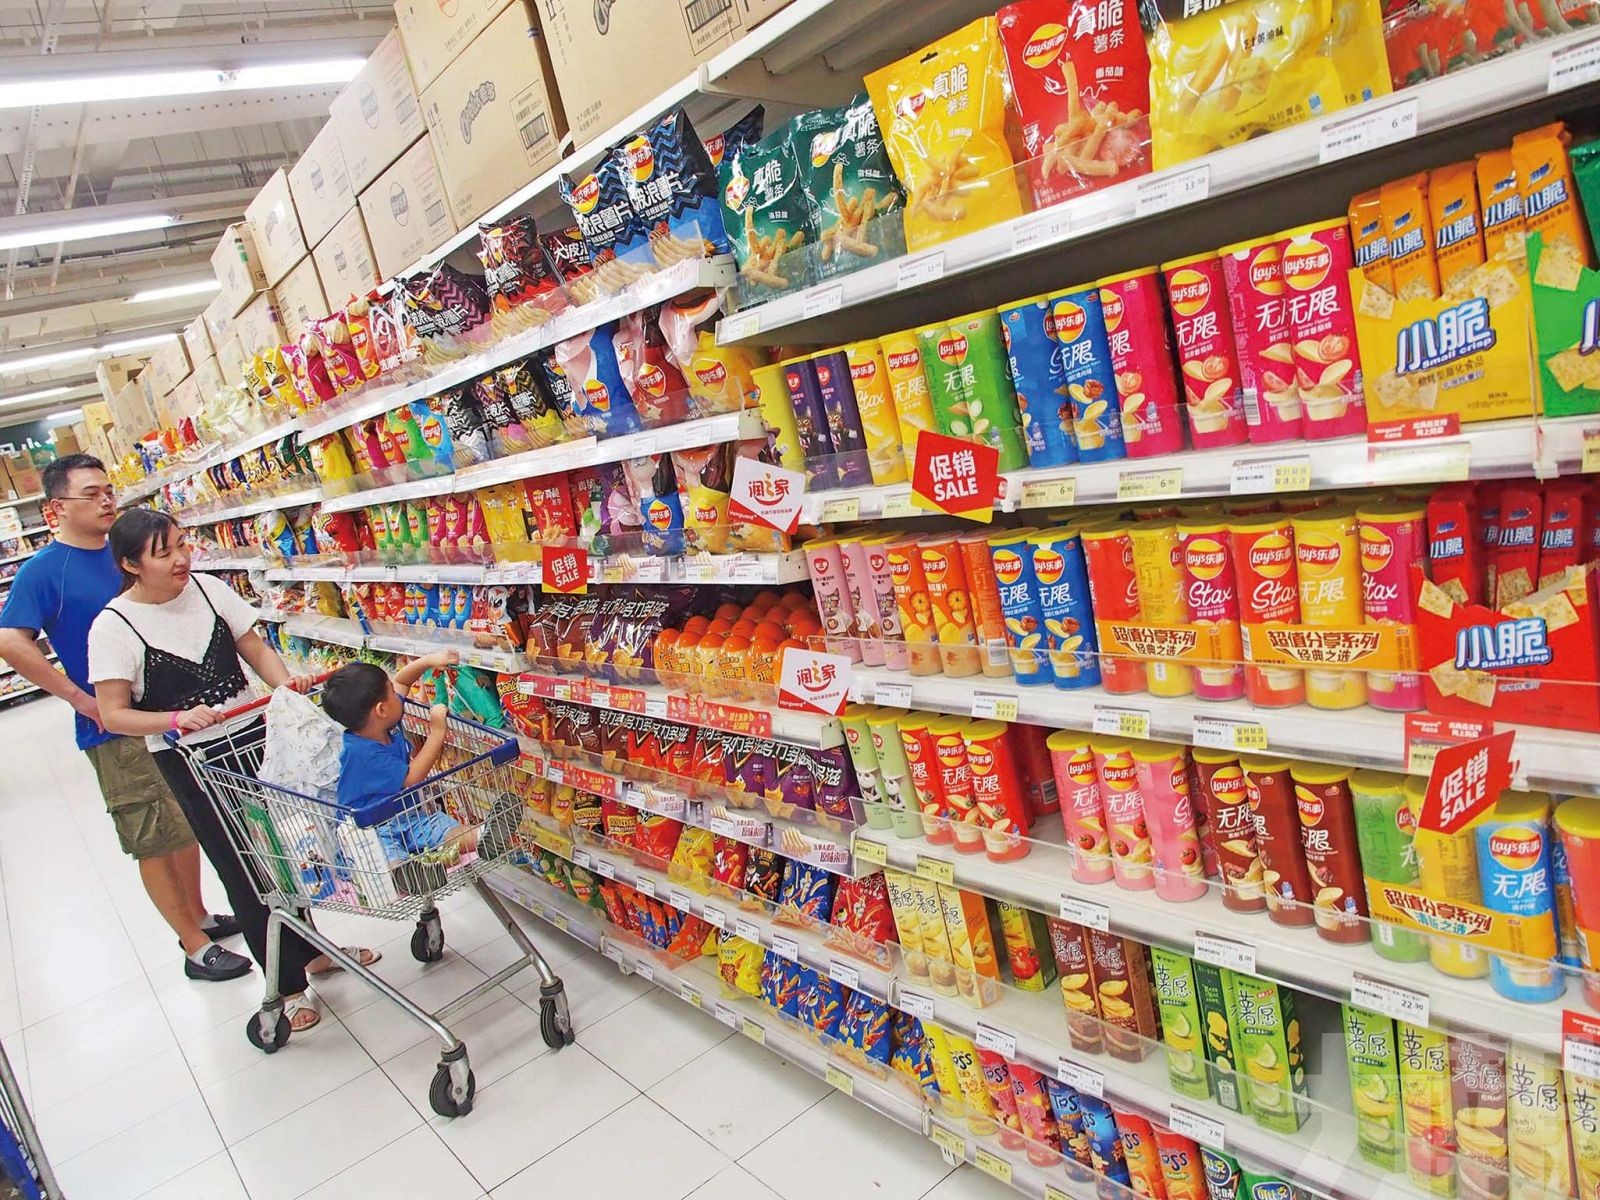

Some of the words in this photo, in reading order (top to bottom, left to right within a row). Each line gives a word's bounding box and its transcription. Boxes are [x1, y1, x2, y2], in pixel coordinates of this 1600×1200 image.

[1093, 28, 1125, 54] 薯条
[932, 63, 969, 104] 真脆
[1095, 66, 1124, 79] 番茄味
[854, 138, 880, 158] 薯条
[1525, 178, 1569, 219] 小脆
[1389, 227, 1427, 260] 小脆
[1436, 215, 1478, 250] 小脆
[1290, 286, 1340, 327] 无限
[1175, 311, 1220, 347] 无限
[1398, 297, 1489, 373] 小脆
[894, 375, 927, 402] 无限
[929, 450, 976, 484] 促销
[748, 472, 790, 498] 润之家
[933, 477, 979, 502] SALE
[1429, 535, 1464, 558] 小脆
[1498, 524, 1536, 546] 小脆
[1541, 527, 1574, 548] 小脆
[551, 552, 578, 577] 促销
[555, 569, 580, 588] SALE
[1301, 576, 1346, 603] 无限
[1040, 581, 1073, 608] 无限
[1188, 580, 1233, 608] Stax
[1251, 579, 1298, 610] Stax
[1112, 625, 1197, 648] 超值分享系列
[1134, 641, 1178, 657] 经典之选
[1267, 629, 1381, 651] 超值分享系列
[1455, 619, 1550, 671] 小脆
[1296, 647, 1352, 664] 经典之选
[796, 659, 837, 686] 润之家
[942, 767, 973, 786] 无限
[972, 774, 1000, 793] 无限
[1440, 746, 1490, 806] 促销
[1439, 780, 1487, 828] SALE
[1490, 837, 1541, 856] Lay's乐事
[1493, 873, 1548, 898] 无限
[1384, 888, 1493, 932] 超值分享系列
[1415, 913, 1467, 936] 清新之选
[1155, 962, 1192, 998] 薯愿
[1237, 988, 1279, 1027] 薯愿
[1346, 1016, 1391, 1058] 薯愿
[1400, 1028, 1448, 1073] 薯愿
[1452, 1043, 1504, 1092] 薯愿
[1508, 1061, 1562, 1112] 薯愿
